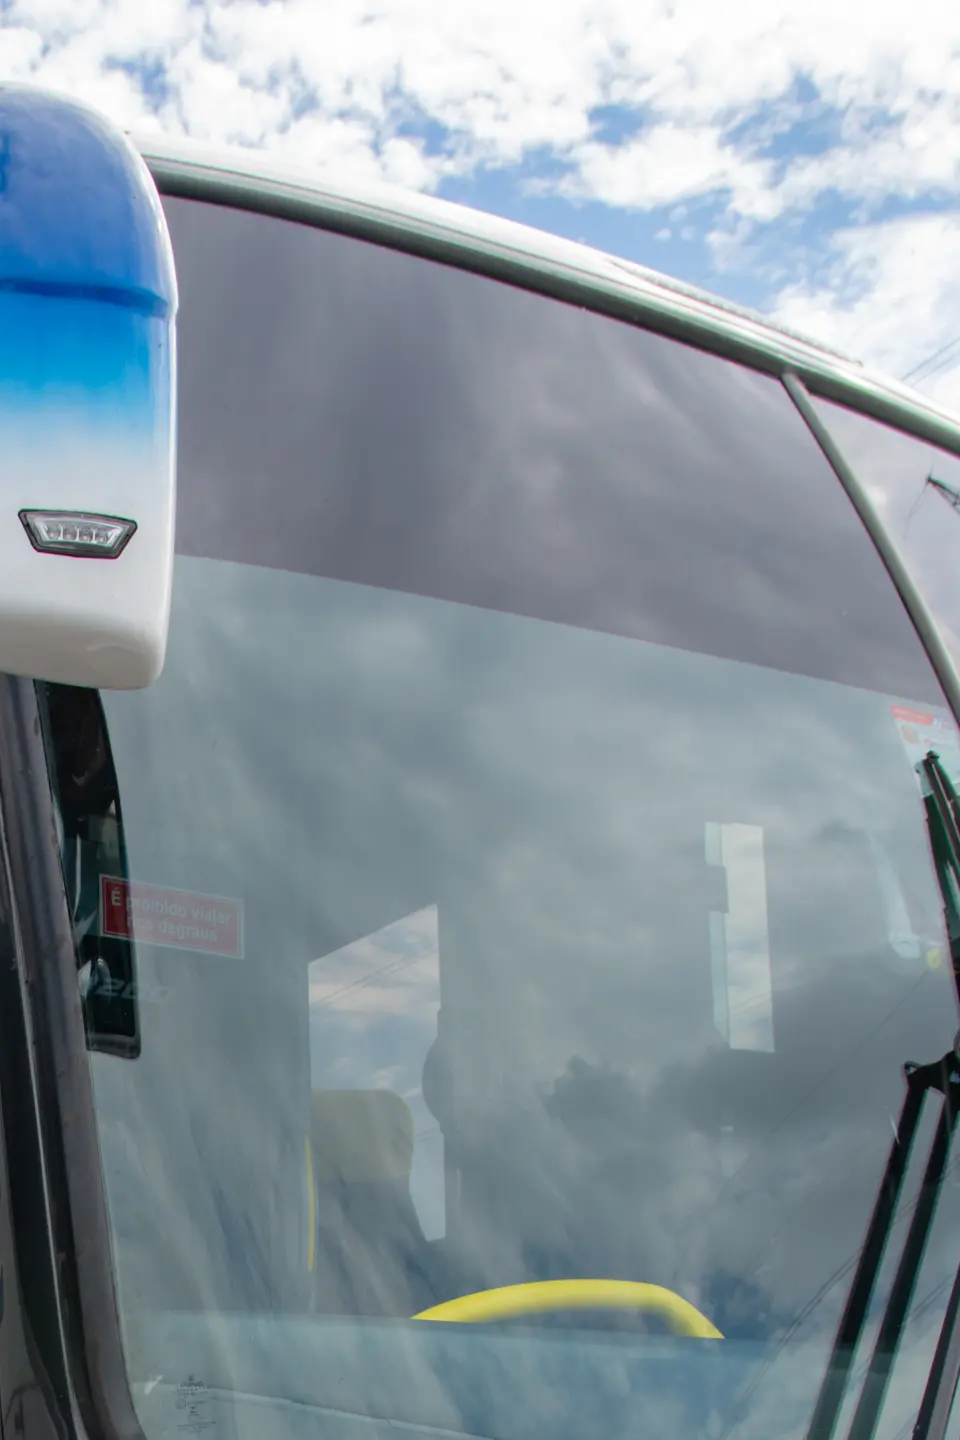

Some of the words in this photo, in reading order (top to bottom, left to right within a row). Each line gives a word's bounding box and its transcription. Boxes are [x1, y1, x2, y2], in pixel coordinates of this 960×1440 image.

[126, 897, 187, 916] proibido
[192, 906, 232, 927] viajar
[158, 918, 217, 942] degraus
